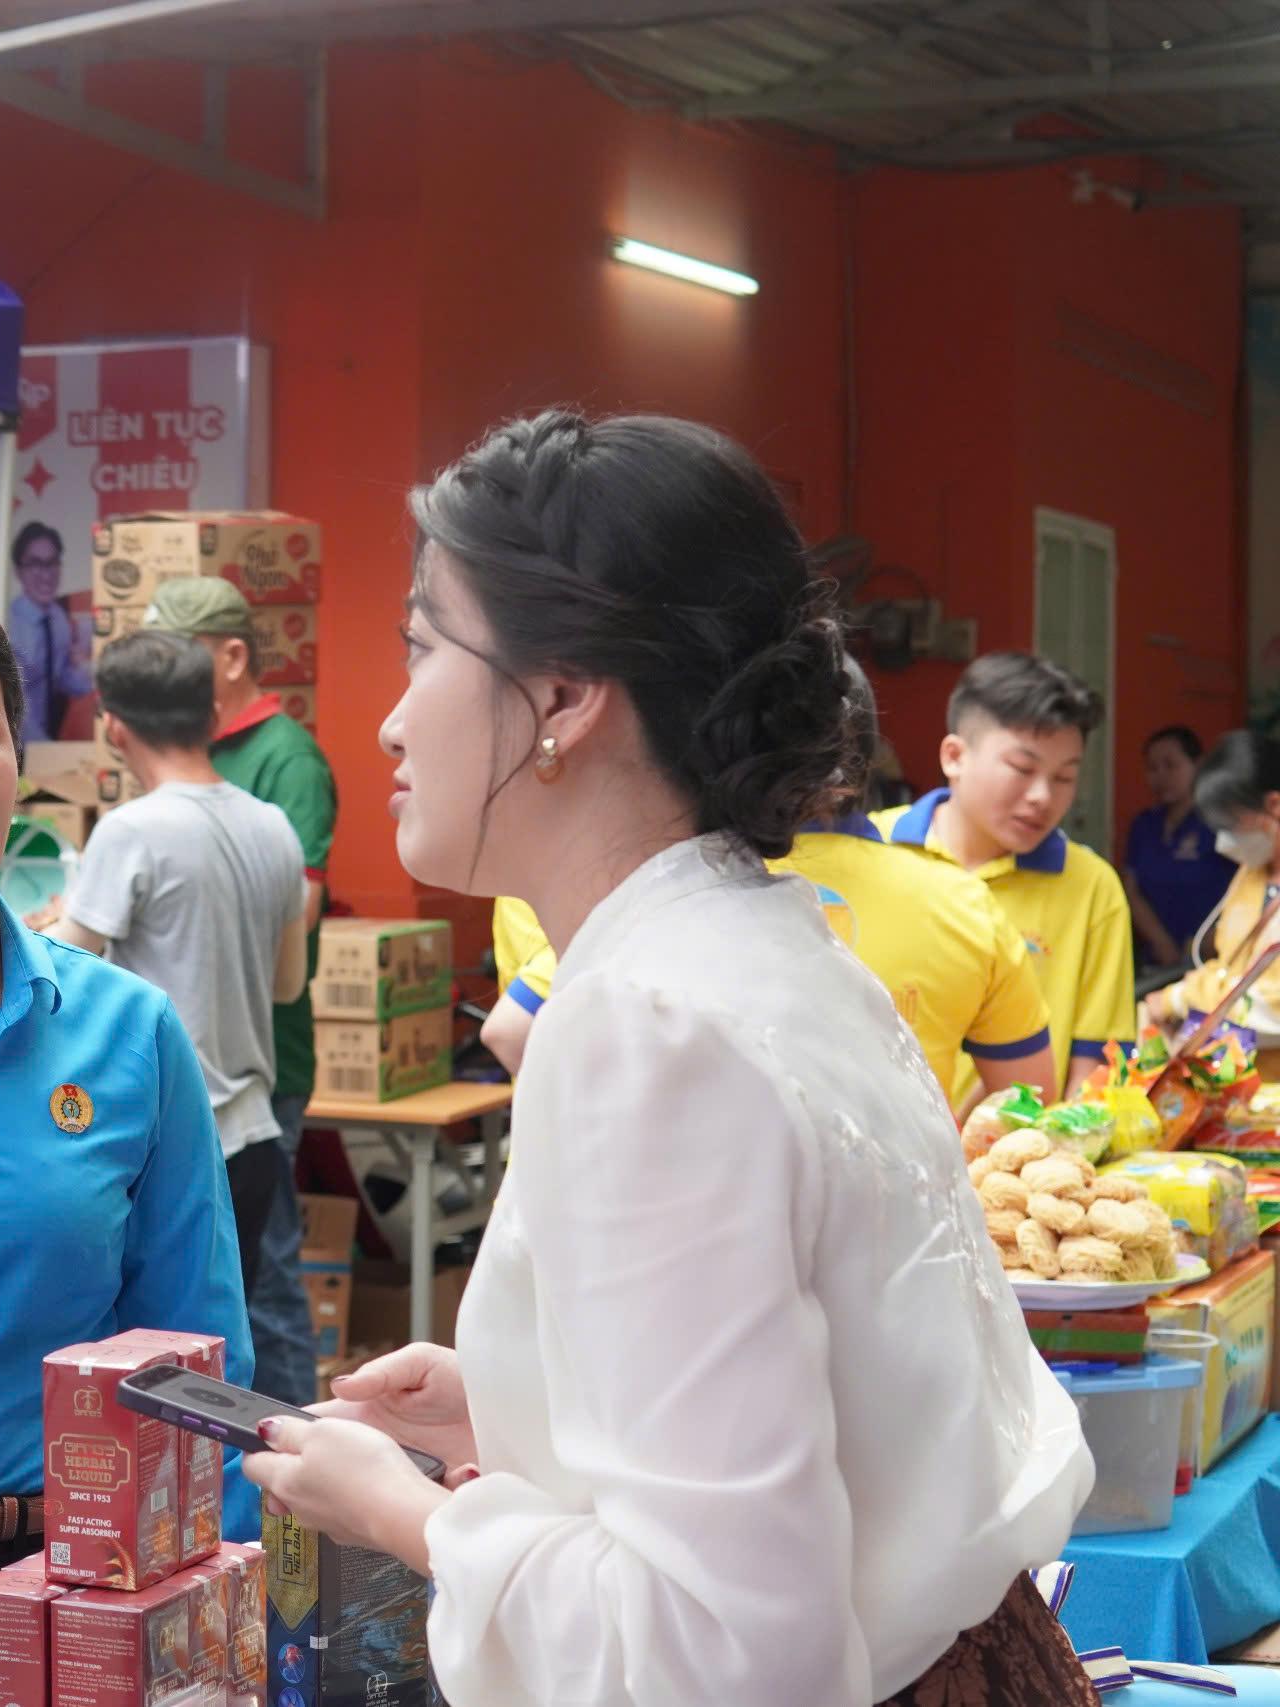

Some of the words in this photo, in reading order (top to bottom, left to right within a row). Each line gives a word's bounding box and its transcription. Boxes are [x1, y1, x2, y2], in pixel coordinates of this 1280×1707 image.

[71, 405, 144, 443] LIÊN
[152, 408, 222, 446] TỤC
[64, 1455, 116, 1471] HERBAL
[68, 1469, 113, 1484] LIQUID
[69, 1491, 91, 1501] SINCE
[93, 1493, 112, 1504] 1953
[67, 1515, 112, 1528] FAST-ACTING
[59, 1525, 80, 1535] SUPER
[81, 1527, 122, 1539] ABSORBENT
